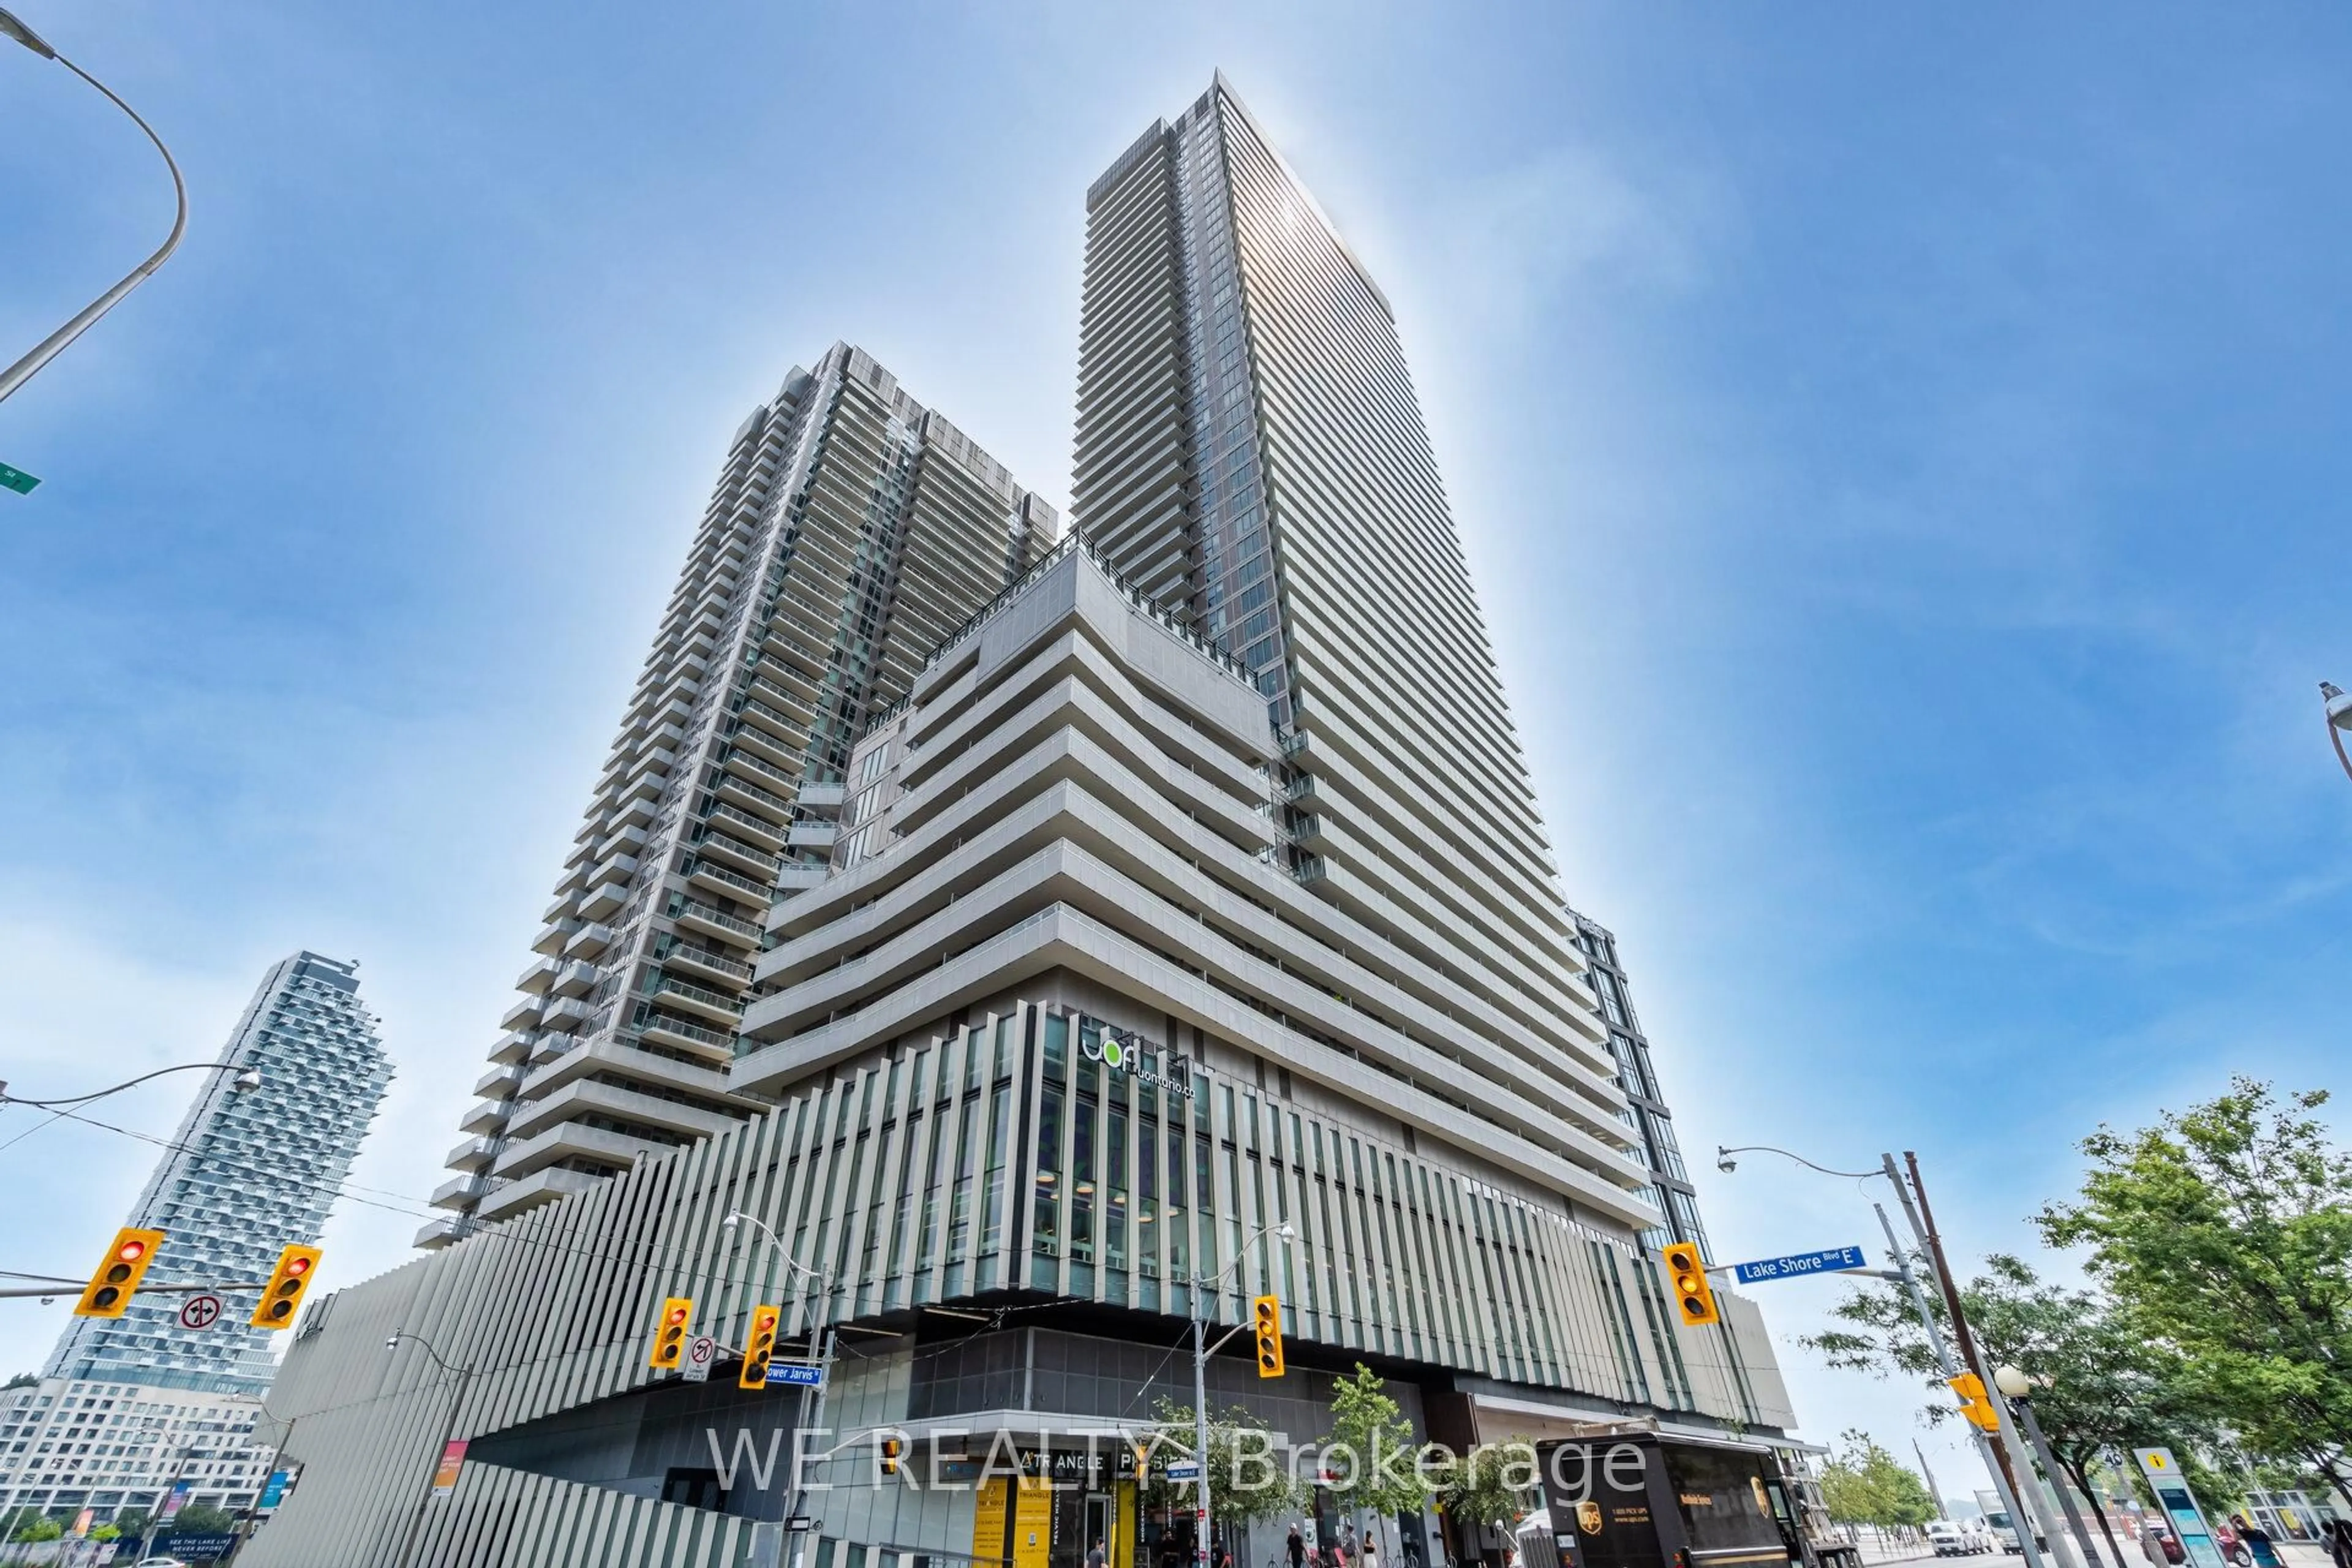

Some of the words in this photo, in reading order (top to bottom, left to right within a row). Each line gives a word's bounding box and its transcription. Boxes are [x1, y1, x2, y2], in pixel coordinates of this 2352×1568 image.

[1137, 1068, 1195, 1098] uontario.ca
[1744, 1264, 1777, 1279] Lake
[1779, 1256, 1822, 1273] Shore
[1823, 1251, 1839, 1261] Blvd
[1842, 1249, 1854, 1264] E
[766, 1368, 788, 1378] ower
[790, 1368, 813, 1380] Jarvis
